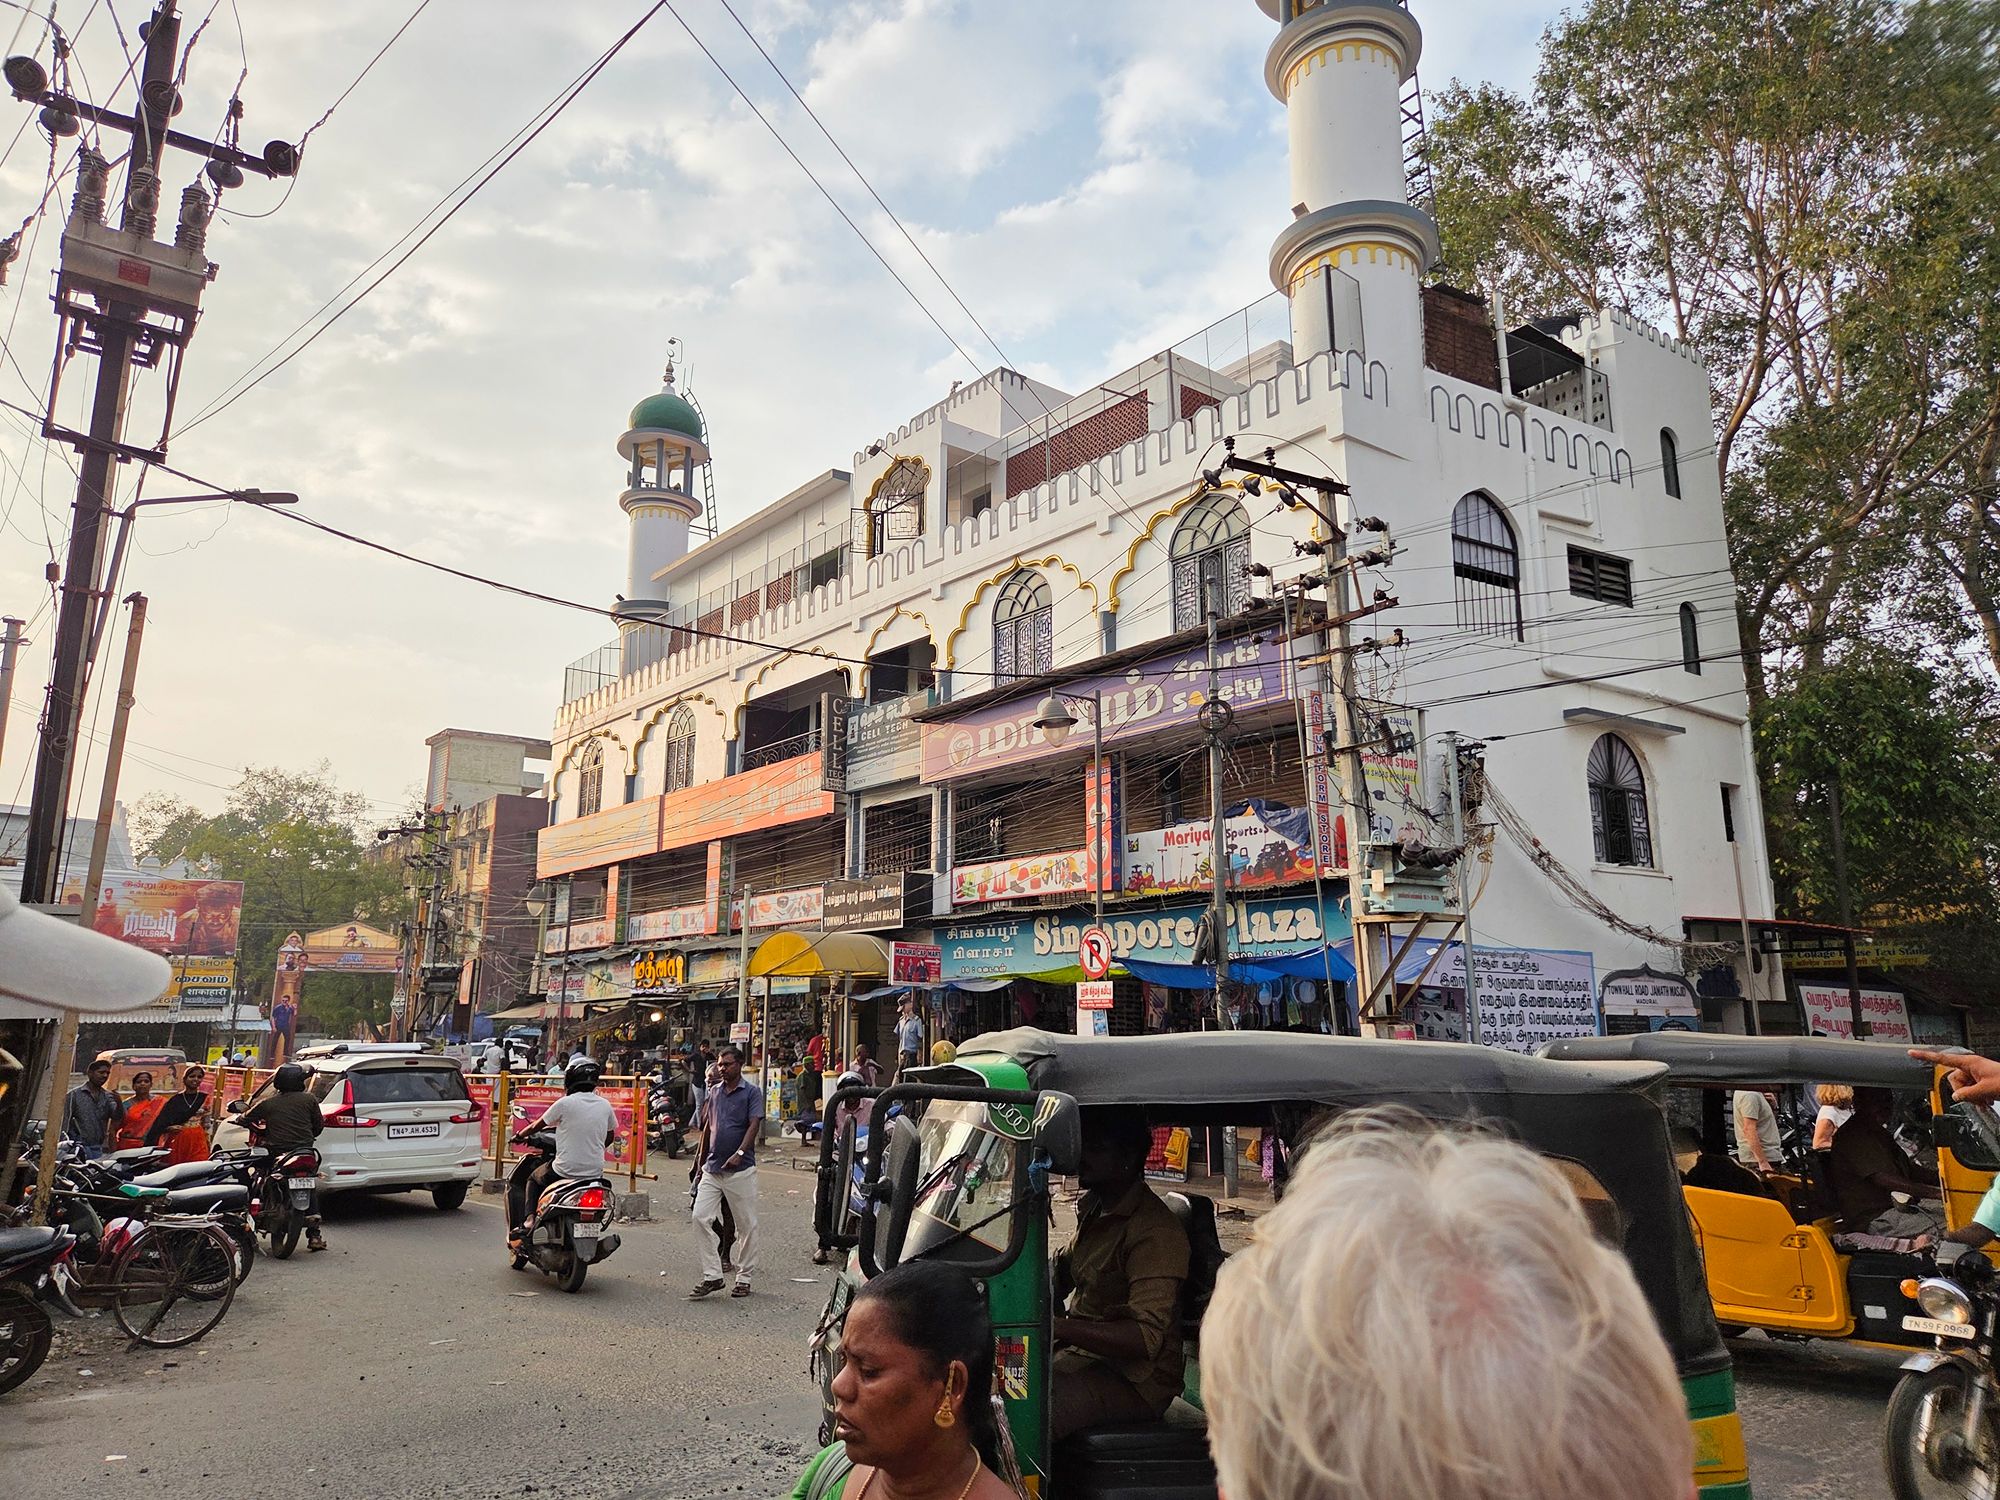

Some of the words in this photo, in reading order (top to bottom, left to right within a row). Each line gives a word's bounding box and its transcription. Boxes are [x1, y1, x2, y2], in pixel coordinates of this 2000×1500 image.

[1172, 677, 1263, 714] Sety
[832, 698, 847, 771] CELL
[861, 728, 881, 741] CELL
[1395, 757, 1418, 769] STORE
[827, 769, 845, 779] TEC
[1312, 694, 1322, 725] ALL
[1319, 813, 1330, 864] STORE
[133, 929, 168, 937] PULSAR
[946, 921, 1019, 943] சிங்கப்பூர்
[1033, 914, 1197, 958] Sinapore
[174, 974, 229, 983] சைவம்
[187, 987, 227, 997] शाकाहारी
[1634, 985, 1649, 997] ROAD
[1479, 992, 1516, 1009] எதையும்
[1806, 991, 1832, 1013] பொது
[1832, 990, 1903, 1015] போவரத்துக்கு
[1500, 1009, 1526, 1028] நன்றி
[1811, 1012, 1854, 1040] இடையூறா
[1908, 1319, 1921, 1328] TN
[1922, 1321, 1933, 1331] 59
[1936, 1323, 1941, 1331] F
